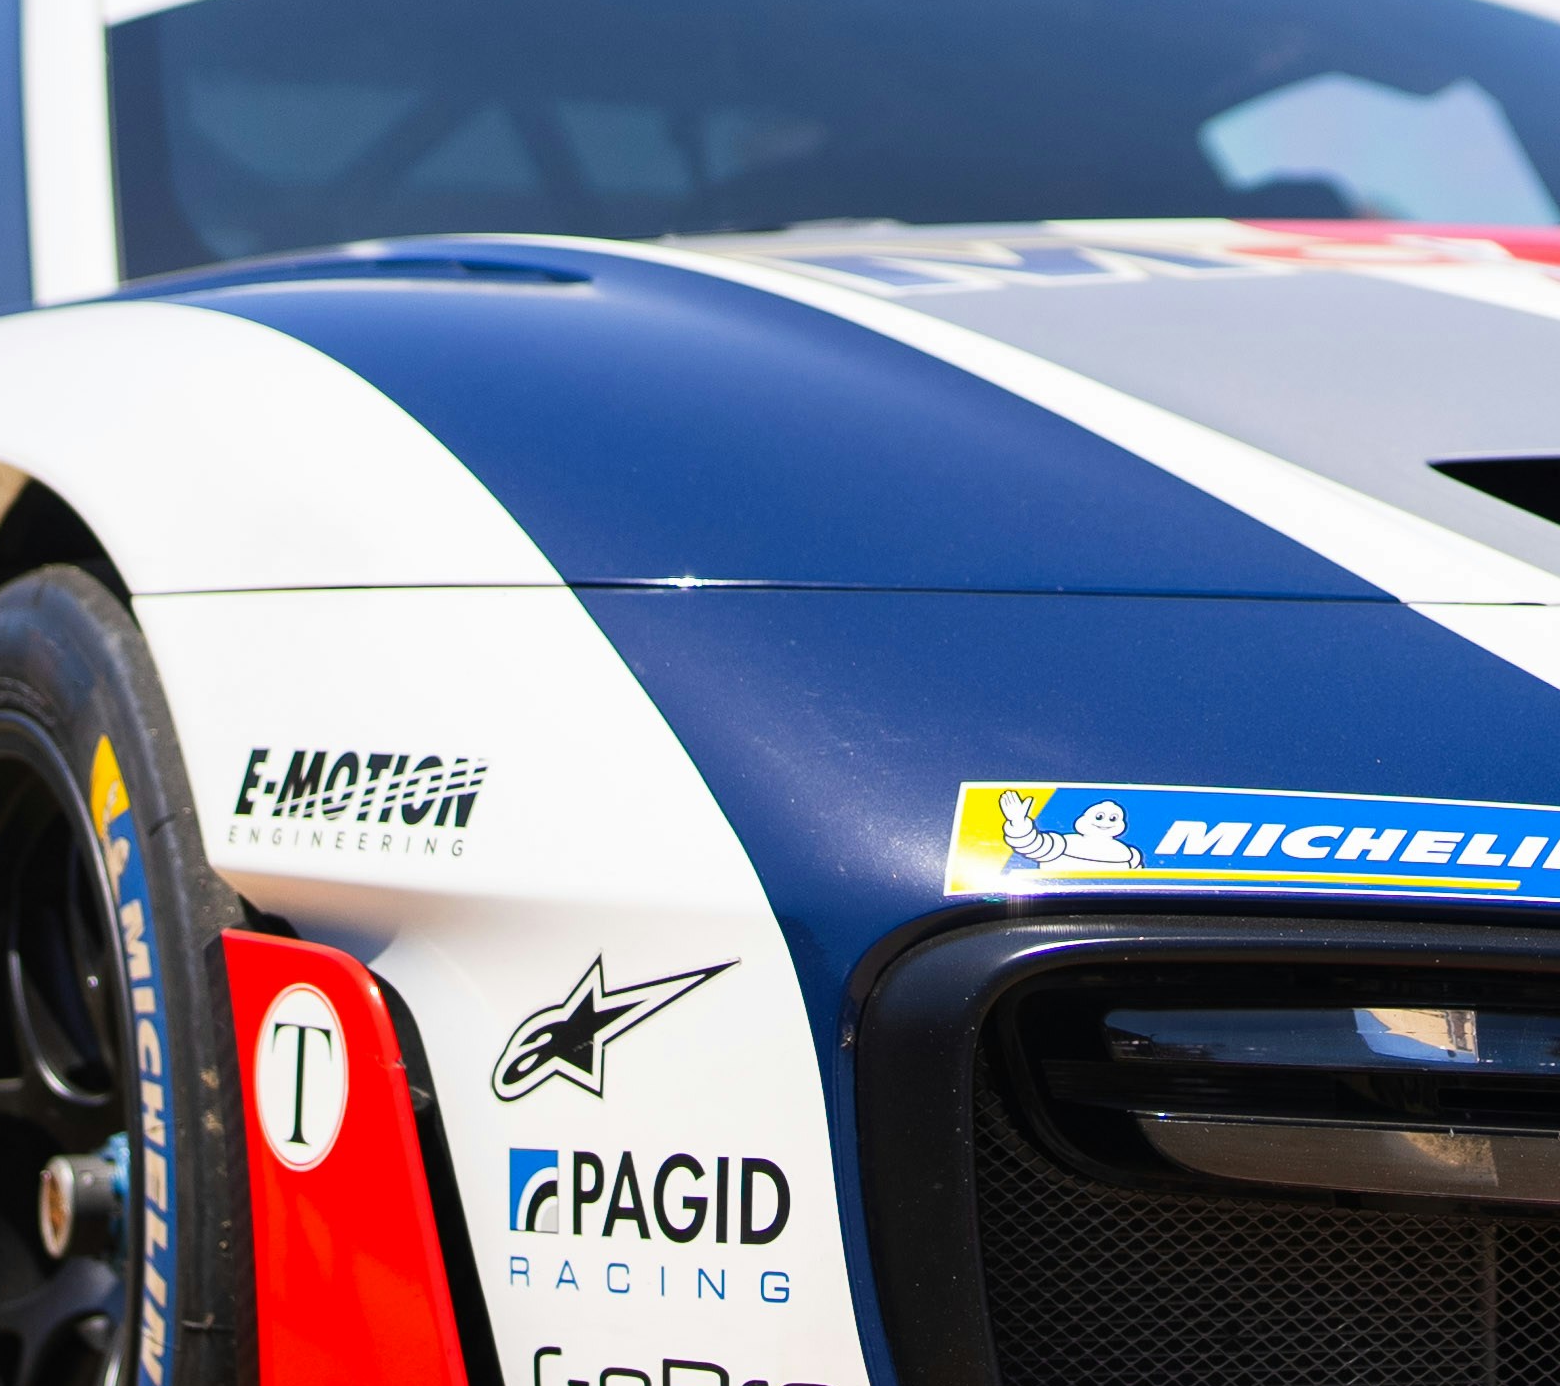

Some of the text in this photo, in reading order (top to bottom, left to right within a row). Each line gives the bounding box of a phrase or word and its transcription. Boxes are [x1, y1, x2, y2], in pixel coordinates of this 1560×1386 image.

[234, 748, 489, 828] E-MOTION
[228, 825, 465, 858] ENGINEERING
[271, 1022, 332, 1146] T
[572, 1150, 791, 1245] PAGID
[508, 1255, 791, 1304] RACING
